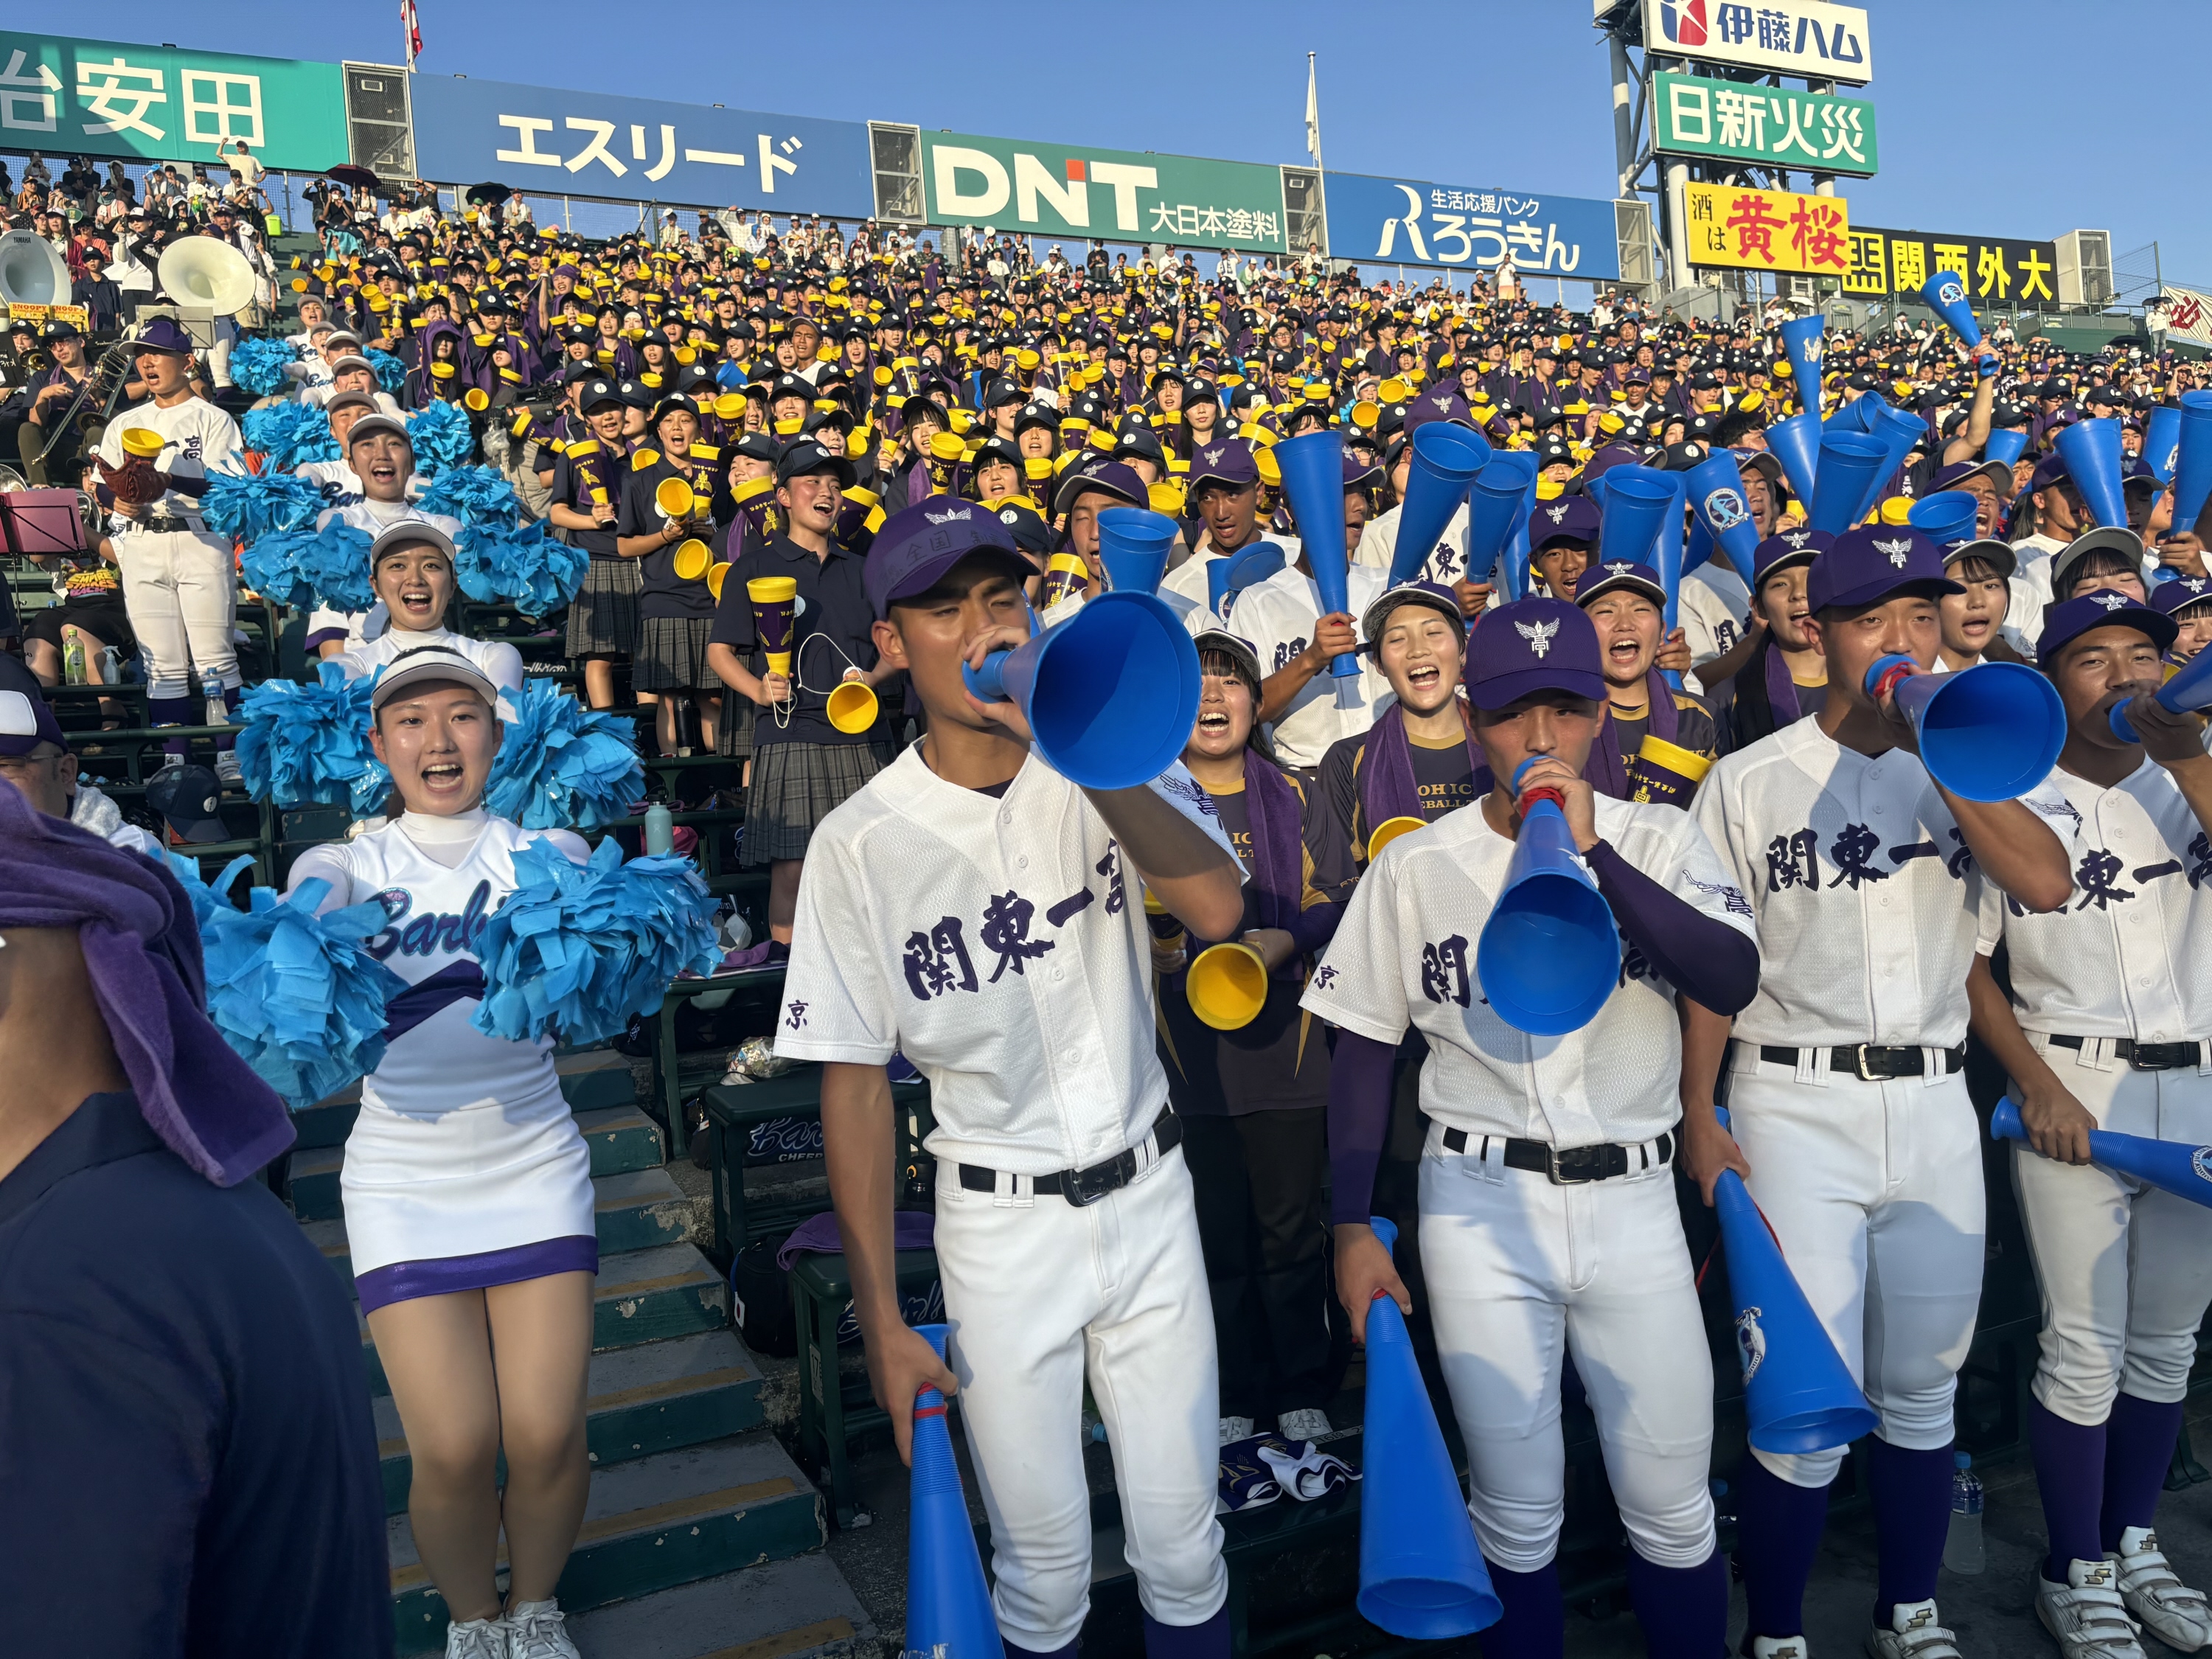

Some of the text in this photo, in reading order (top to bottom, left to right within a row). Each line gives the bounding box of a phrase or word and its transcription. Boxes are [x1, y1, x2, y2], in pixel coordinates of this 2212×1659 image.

[1716, 2, 1863, 64] 伊藤ハム
[1669, 83, 1866, 164] 日新火災
[496, 114, 803, 193] エスリード
[932, 145, 1158, 231] DNT
[1430, 189, 1540, 218] 生活応援バンク
[13, 236, 31, 244] YAMAHA
[1149, 201, 1280, 243] 大日本塗料
[1726, 194, 1847, 269] 黄桜
[1432, 214, 1580, 273] ろうきん
[1891, 240, 2053, 302] 関西外大
[2056, 410, 2065, 420] K
[68, 569, 114, 583] EMPIRE
[1450, 783, 1474, 795] IC
[1315, 965, 1336, 990] 京
[785, 999, 810, 1030] 京
